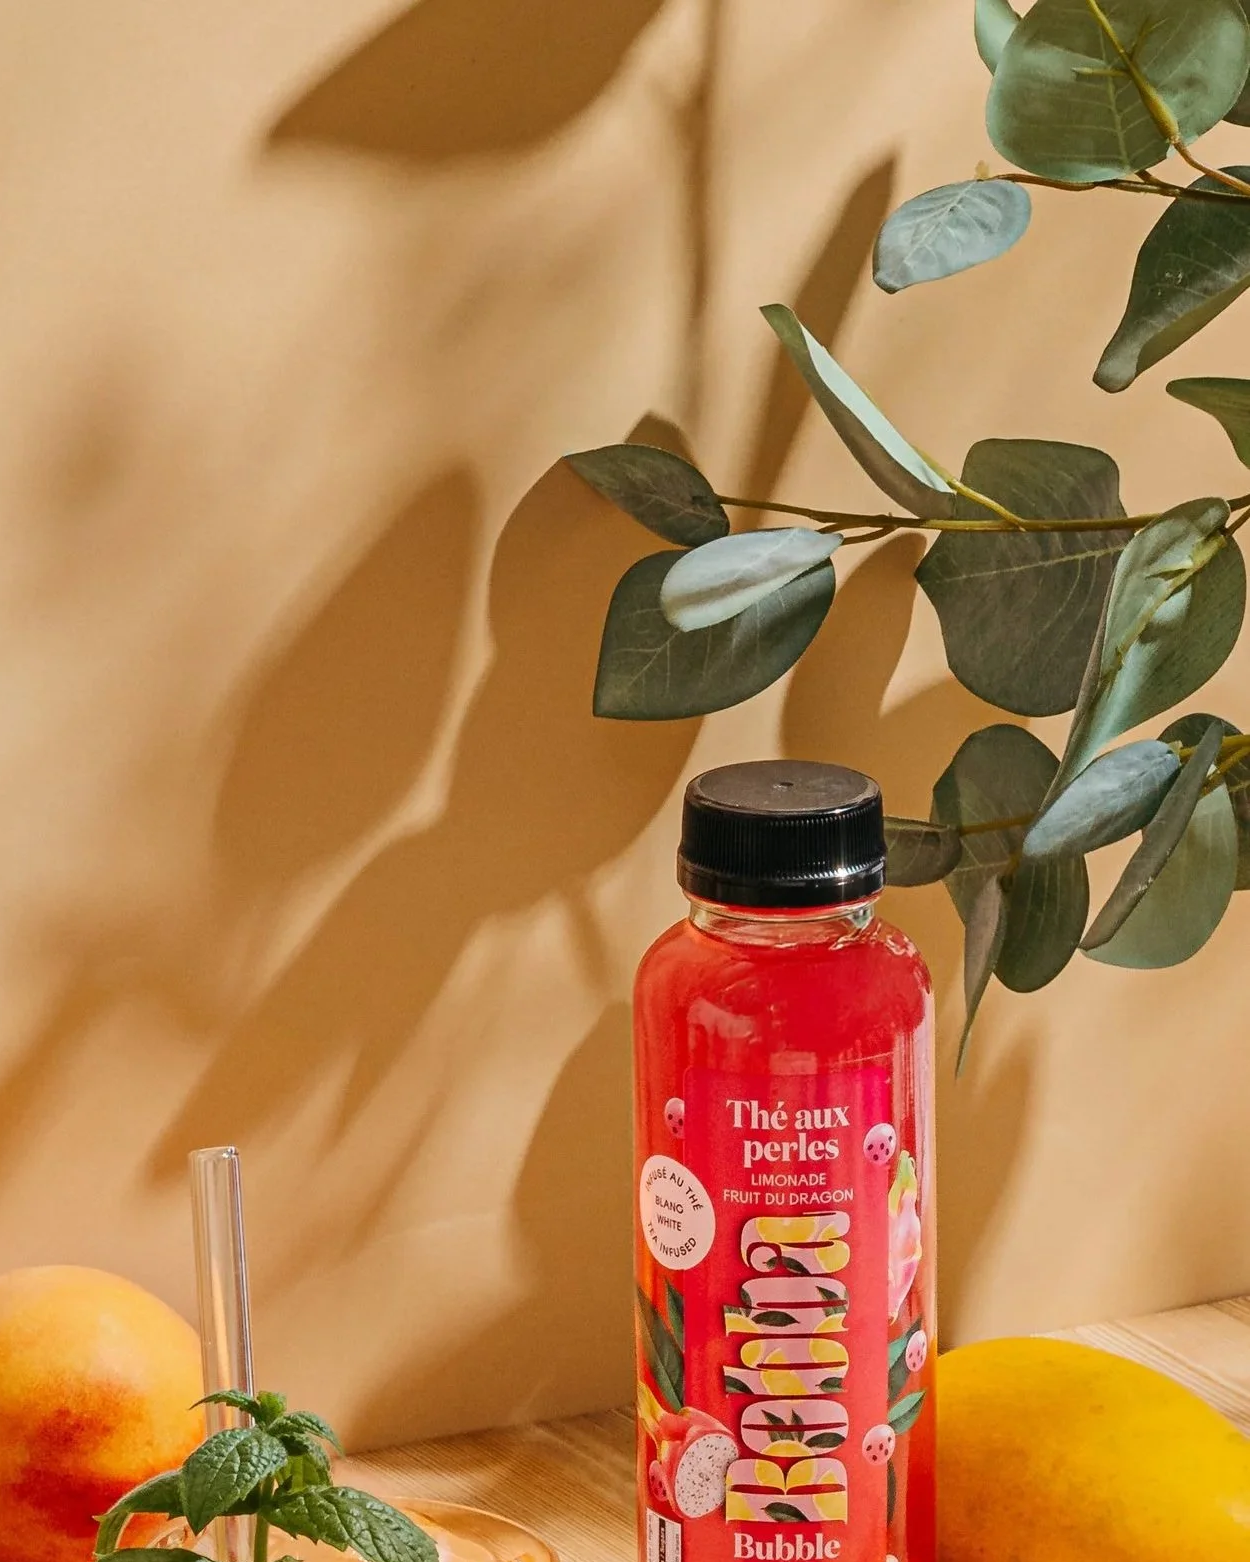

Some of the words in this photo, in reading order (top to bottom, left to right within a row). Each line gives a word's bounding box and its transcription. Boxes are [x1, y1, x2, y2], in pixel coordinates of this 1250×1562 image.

[725, 1099, 788, 1131] Thé
[794, 1106, 850, 1130] aux
[743, 1132, 840, 1168] perles
[646, 1167, 667, 1192] INFUSÉ
[670, 1172, 684, 1187] AU
[685, 1186, 704, 1211] THÉ
[751, 1173, 827, 1187] LIMONADE
[655, 1195, 684, 1214] BLANC
[723, 1189, 761, 1205] FRUIT
[765, 1192, 785, 1206] DU
[790, 1188, 854, 1206] DRAGON
[656, 1213, 682, 1231] WHITE
[647, 1220, 658, 1245] TEA
[659, 1237, 697, 1258] INFUSED
[723, 1211, 851, 1525] Bobba
[733, 1532, 841, 1561] Bubble
